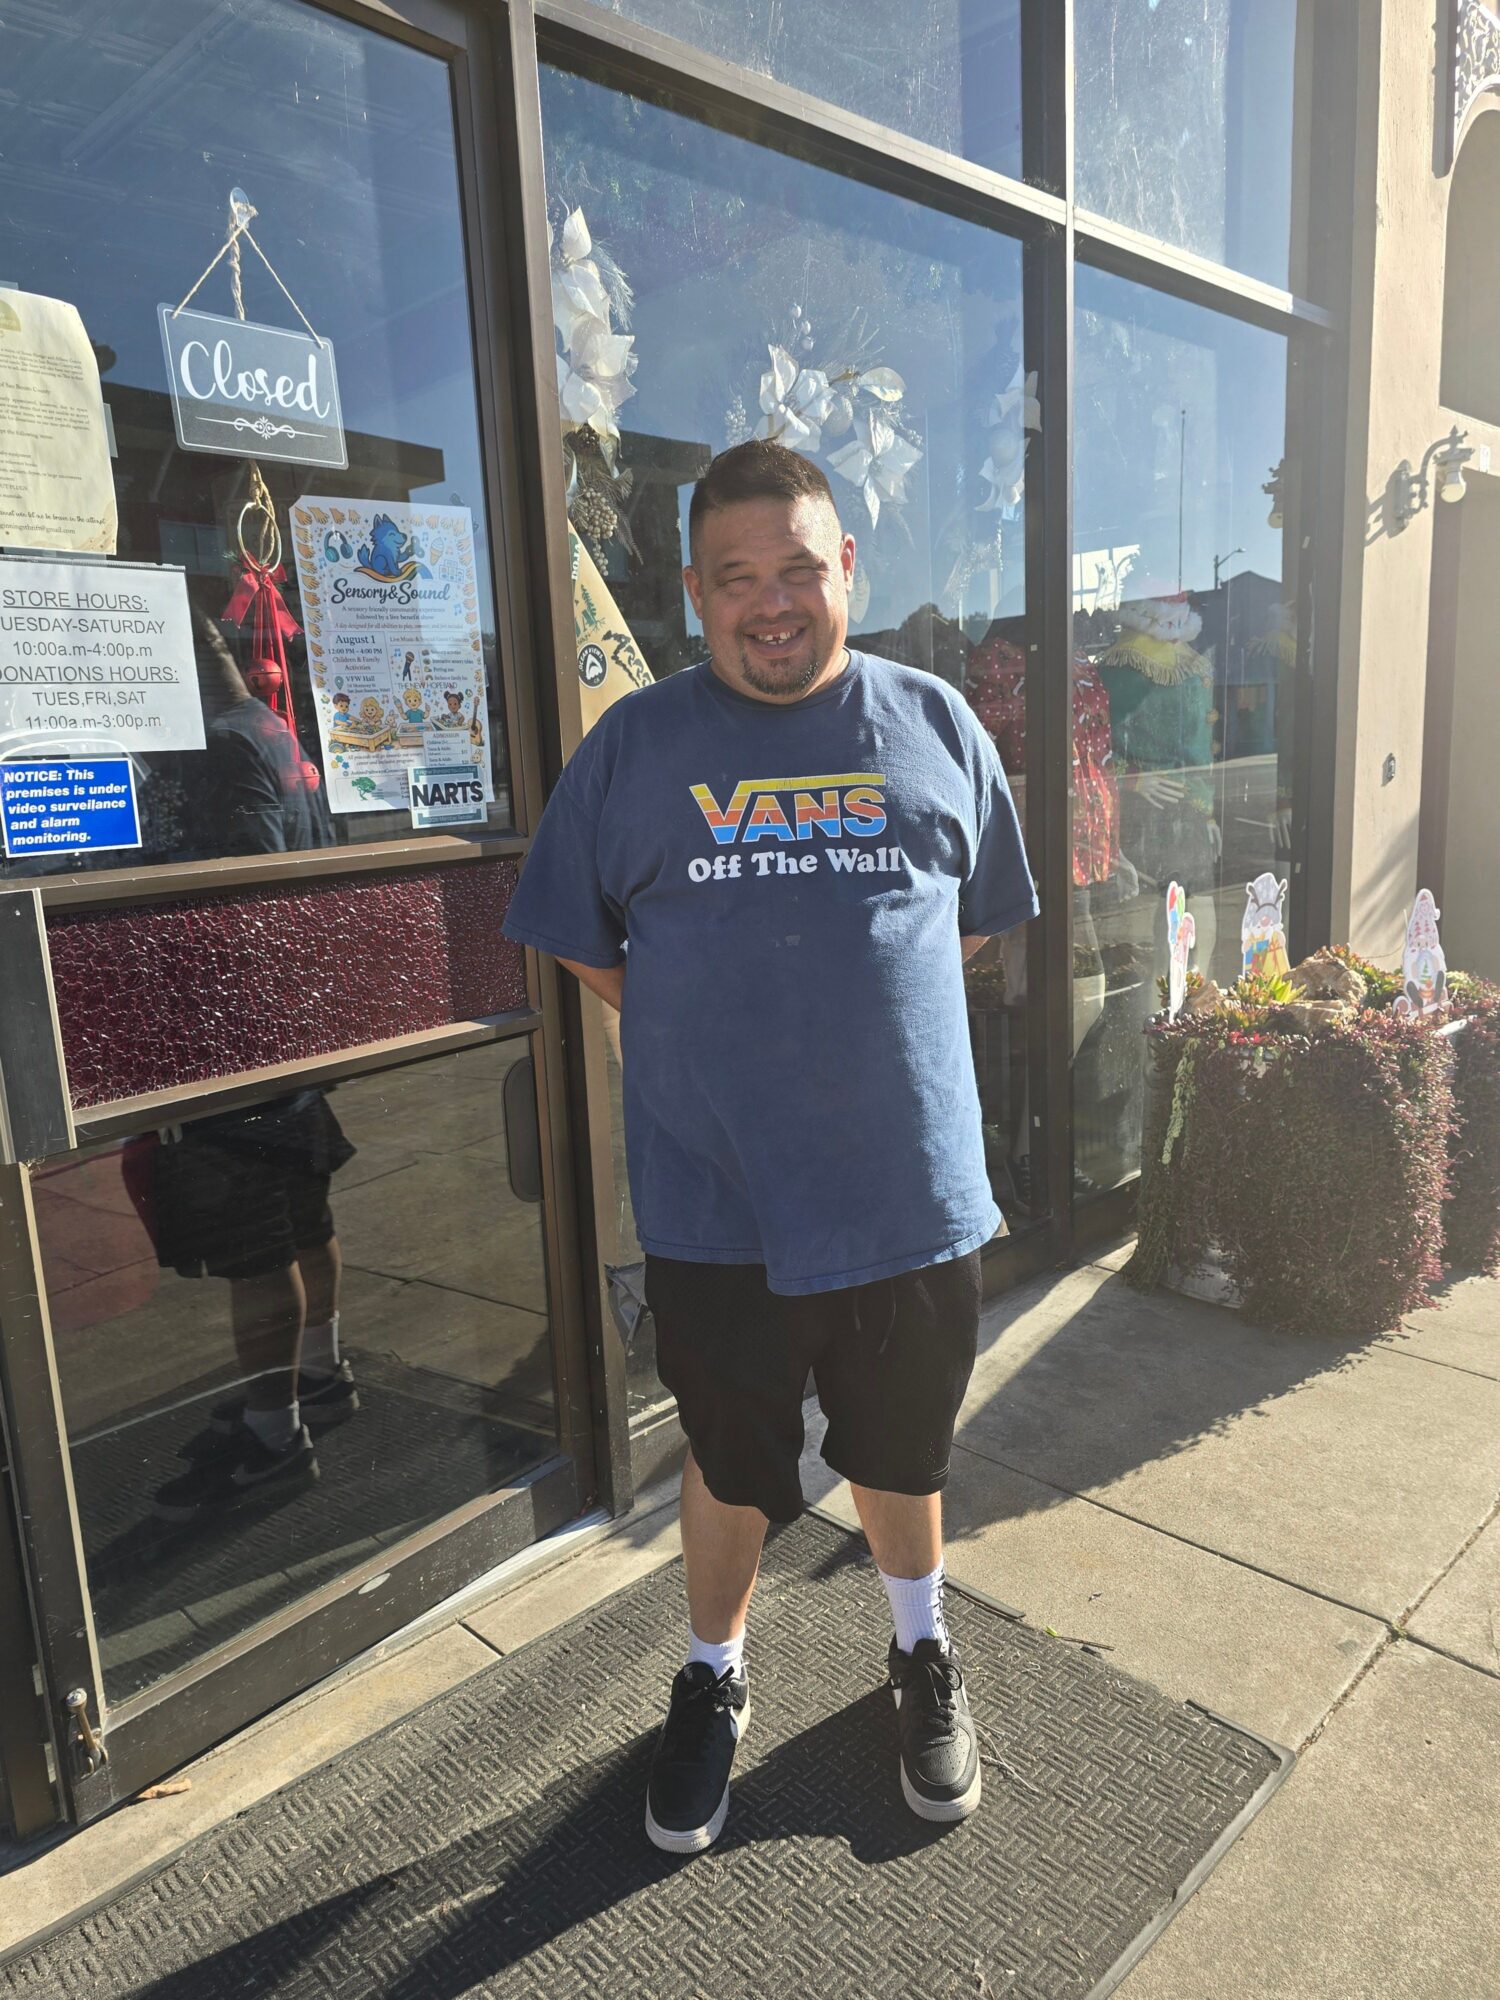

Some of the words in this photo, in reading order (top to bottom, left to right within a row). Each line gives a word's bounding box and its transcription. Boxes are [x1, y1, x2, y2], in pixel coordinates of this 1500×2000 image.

[180, 339, 331, 419] Closed
[3, 589, 71, 608] STORE
[76, 592, 149, 611] HOURS:
[0, 616, 165, 634] UESDAY-SATURDAY
[336, 635, 370, 646] August
[371, 635, 376, 644] 1
[13, 640, 153, 660] 10:00a.m-4:00p.m
[0, 665, 104, 682] ONATIONS
[109, 665, 179, 682] HOURS:
[32, 691, 147, 707] TUES,FRI,SAT
[25, 714, 162, 731] 11:00a.m-3:00p.m
[4, 770, 62, 783] NOTICE:
[66, 769, 95, 781] This
[6, 786, 70, 801] premises
[73, 785, 85, 796] is
[89, 783, 128, 795] under
[411, 781, 484, 807] NARTS
[8, 803, 46, 815] video
[689, 772, 887, 845] VANS
[10, 818, 37, 830] and
[41, 817, 80, 828] alarm
[13, 831, 91, 846] monitoring.
[688, 854, 742, 883] Off
[751, 851, 818, 876] The
[824, 847, 901, 873] Wall
